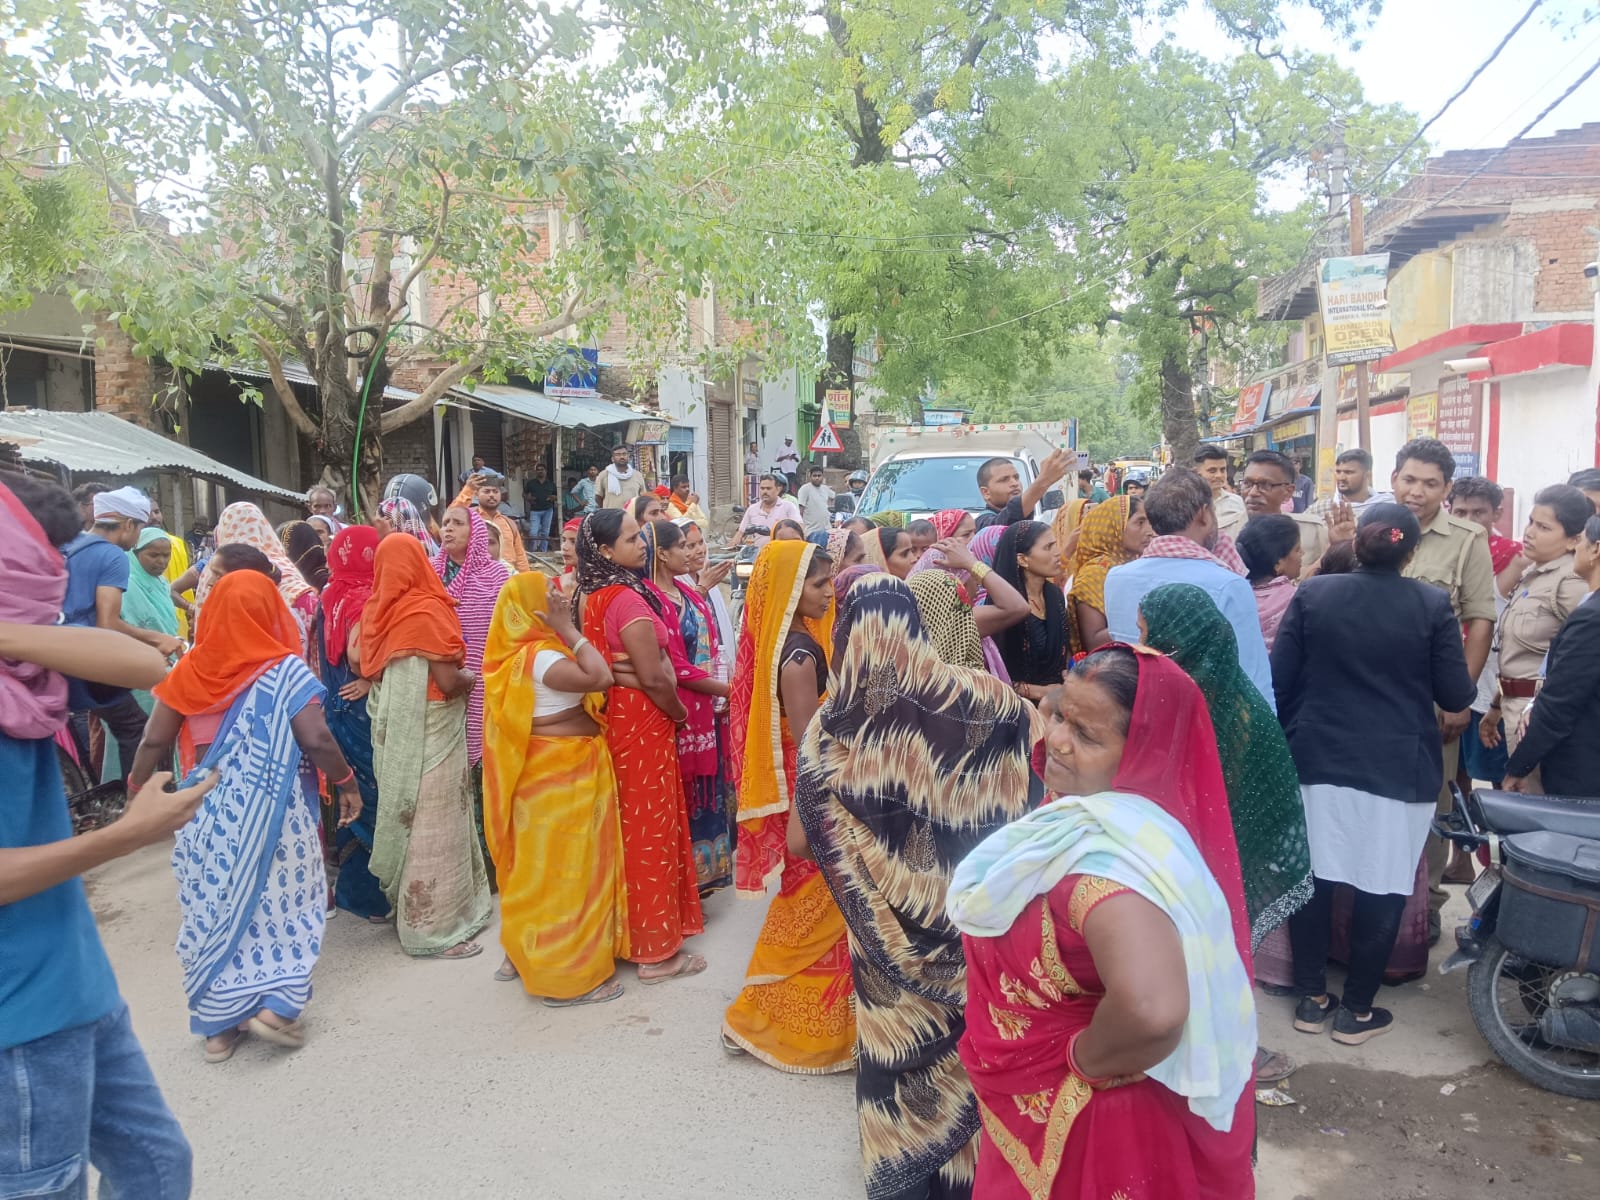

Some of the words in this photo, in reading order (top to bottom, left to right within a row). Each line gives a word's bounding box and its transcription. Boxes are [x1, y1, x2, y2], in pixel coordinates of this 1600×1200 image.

[1328, 294, 1348, 306] HARI
[1328, 304, 1366, 314] INTERNATIONAL
[1334, 320, 1383, 331] ADMISSION
[1335, 328, 1384, 341] OPEN
